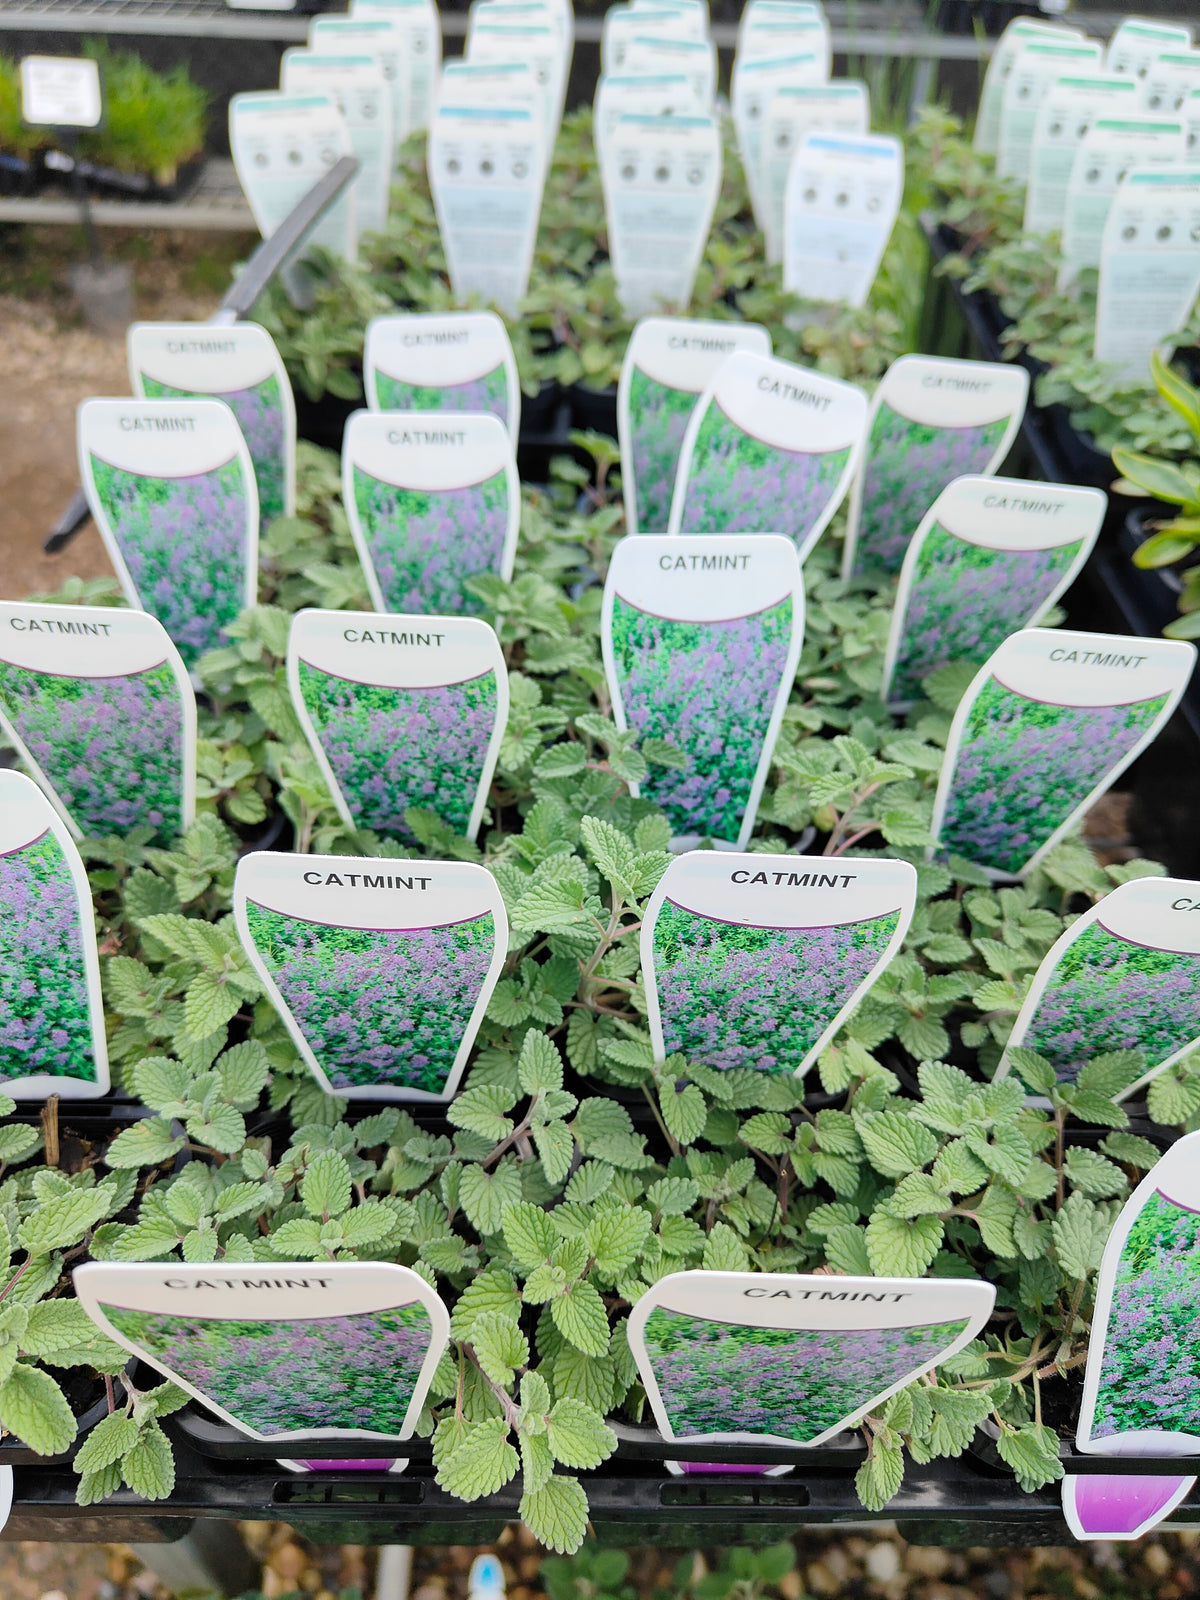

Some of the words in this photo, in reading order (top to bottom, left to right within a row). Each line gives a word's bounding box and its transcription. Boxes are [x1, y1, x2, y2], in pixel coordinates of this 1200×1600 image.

[166, 339, 236, 355] CATMINT
[402, 330, 470, 347] CATMINT
[921, 375, 993, 393] CATMINT
[757, 376, 833, 412] CATMINT
[119, 416, 196, 432] CATMINT
[387, 429, 468, 445] CATMINT
[983, 495, 1066, 515] CATMINT
[659, 554, 751, 571] CATMINT
[9, 617, 112, 637] CATMINT
[343, 629, 446, 647] CATMINT
[1049, 648, 1149, 669] CATMINT
[303, 871, 432, 891] CATMINT
[731, 870, 857, 888] CATMINT
[163, 1278, 332, 1290] CATMINT
[743, 1287, 912, 1304] CATMINT
